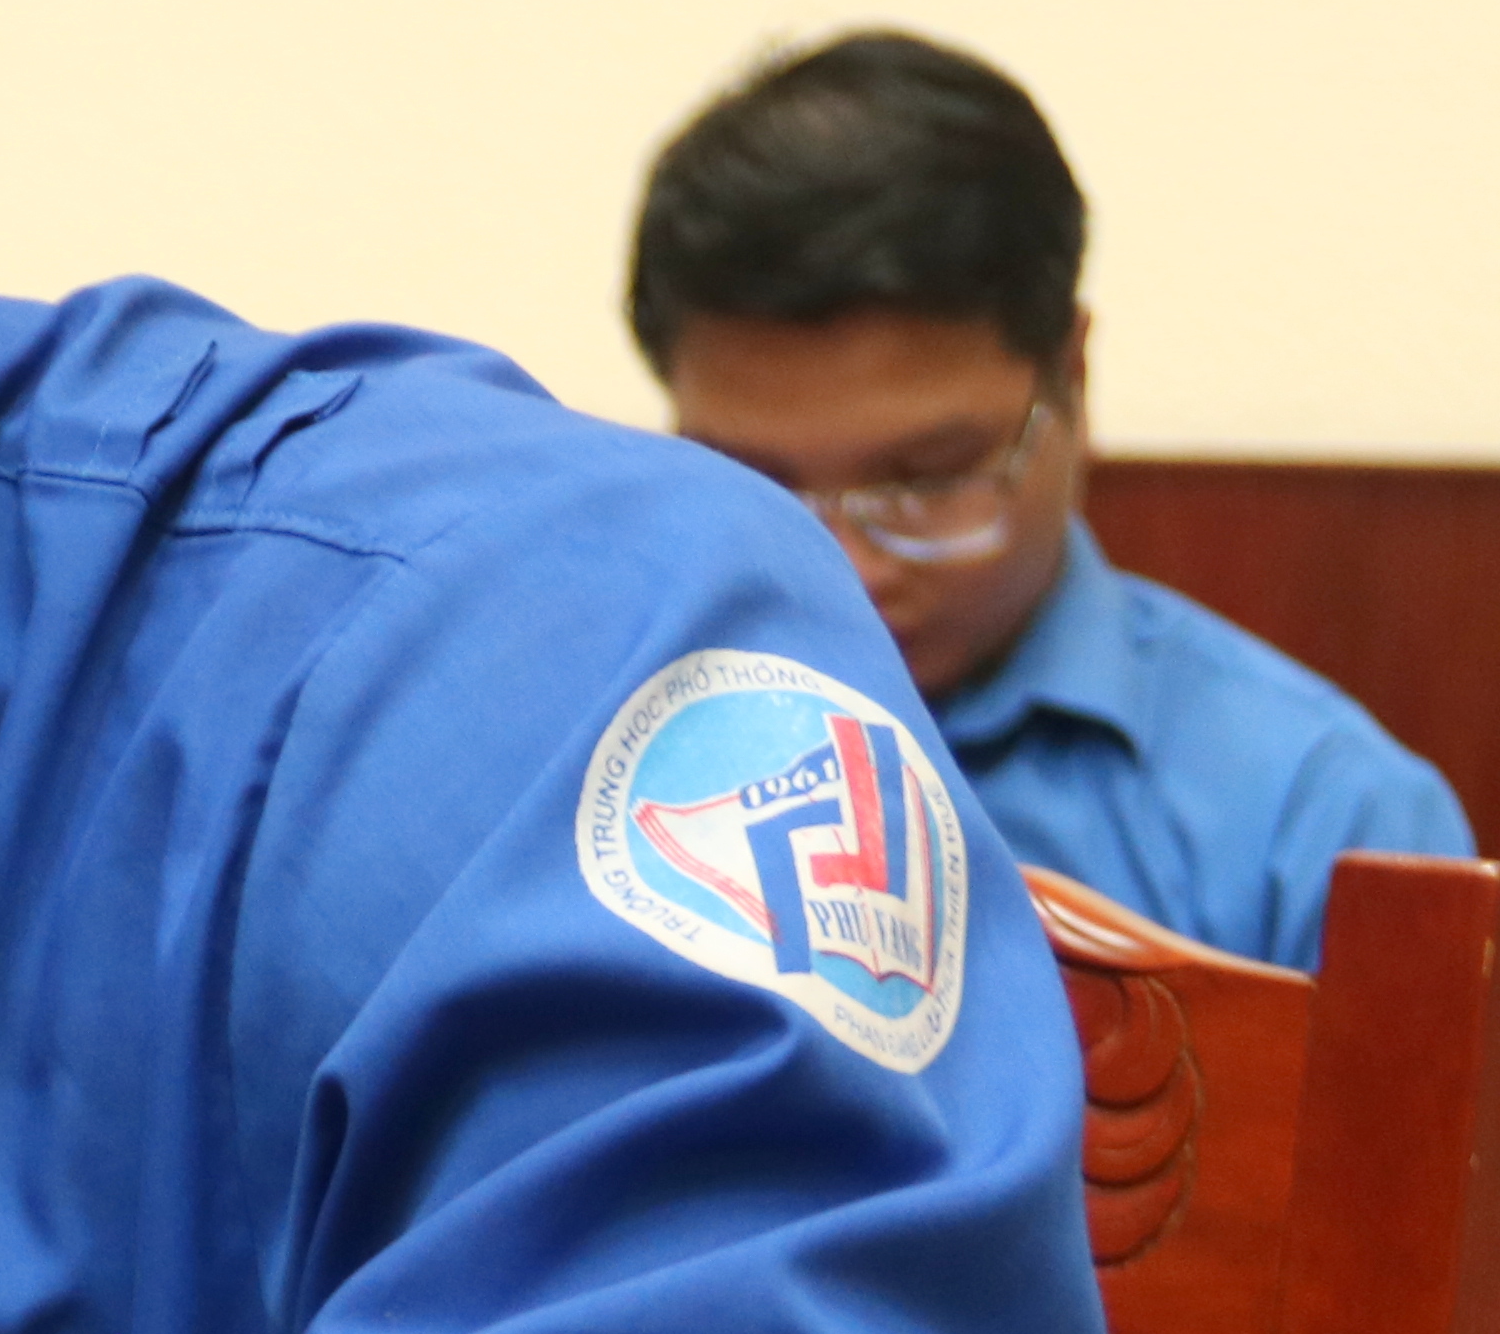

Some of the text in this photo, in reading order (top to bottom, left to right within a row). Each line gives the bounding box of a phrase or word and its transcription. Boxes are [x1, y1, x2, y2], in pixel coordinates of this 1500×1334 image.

[593, 758, 626, 861] TRUNG
[715, 660, 821, 691] THÔNG
[746, 757, 837, 808] 1961
[808, 886, 869, 946] PHÚ
